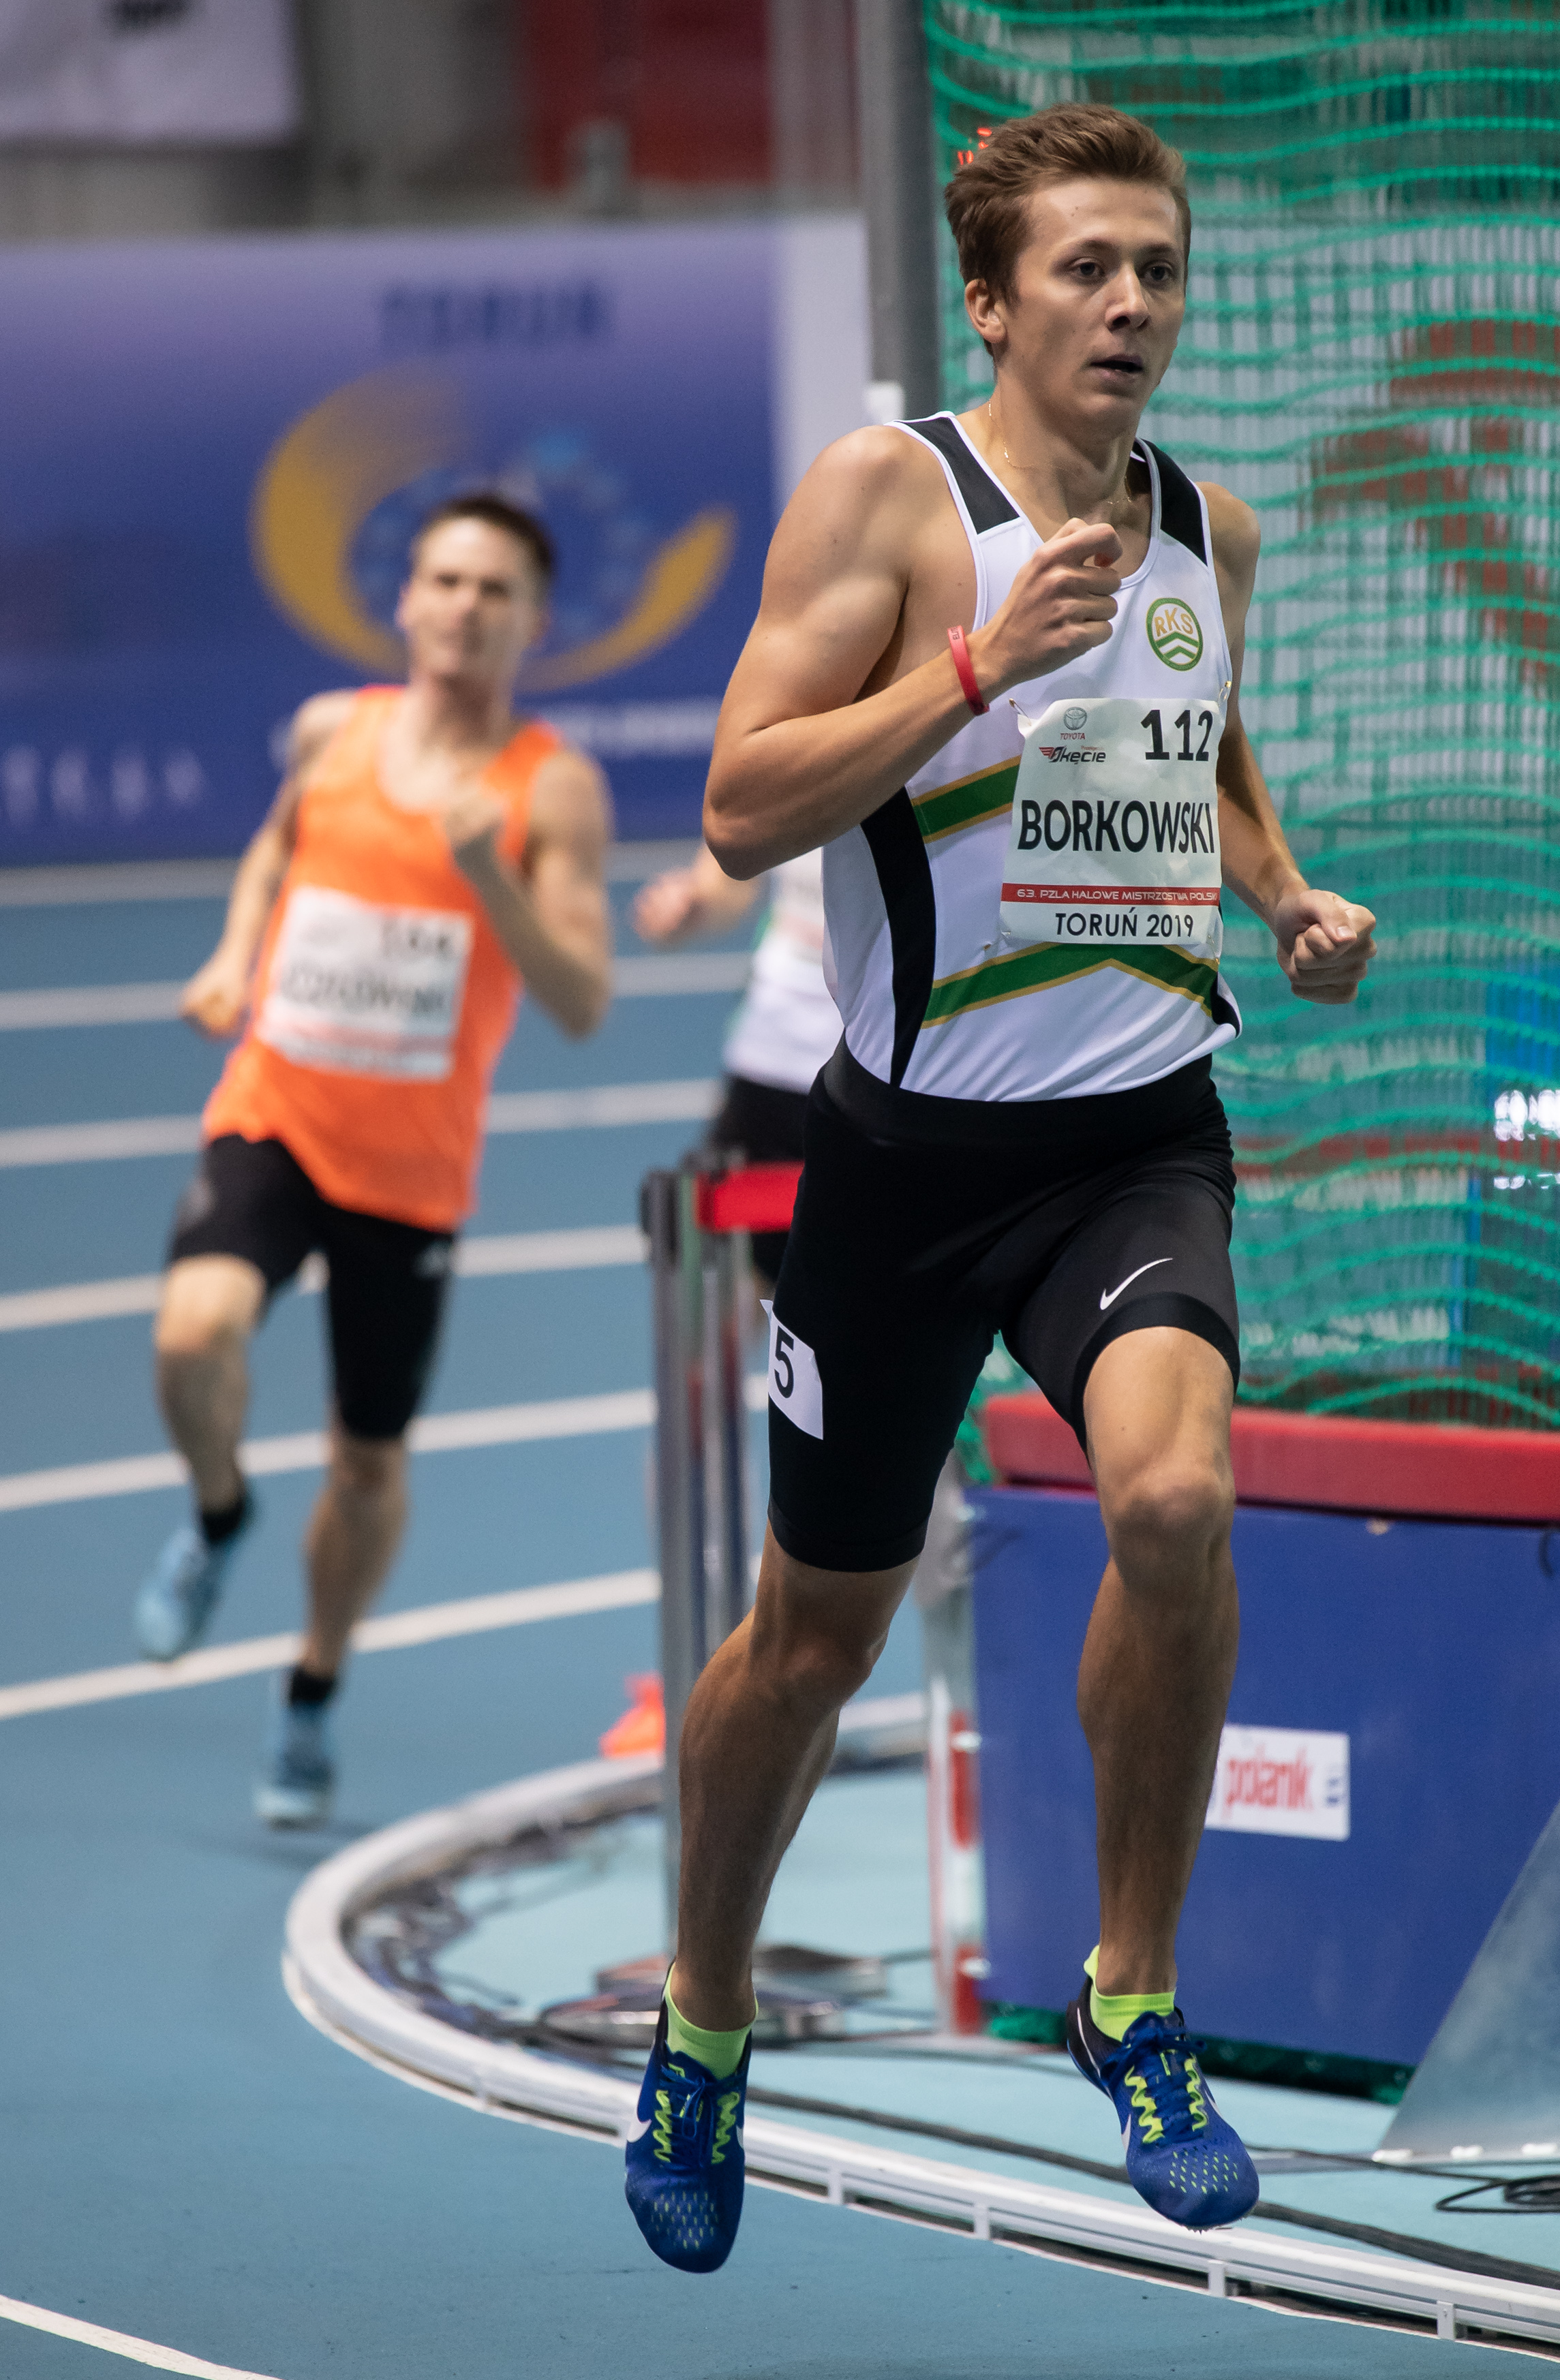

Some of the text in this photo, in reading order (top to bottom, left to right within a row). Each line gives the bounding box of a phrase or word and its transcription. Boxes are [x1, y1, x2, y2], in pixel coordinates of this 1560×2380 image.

[1154, 607, 1194, 637] RKS
[1140, 709, 1214, 762] 112
[1018, 800, 1214, 854] BORKOWSKI
[1017, 888, 1037, 898] 63.
[1040, 889, 1070, 899] PZLA
[1071, 891, 1119, 900] HALOWE
[1122, 891, 1189, 901] MISTRZOSTWA
[1055, 907, 1193, 938] TORUŃ 2019
[774, 1325, 795, 1399] 5
